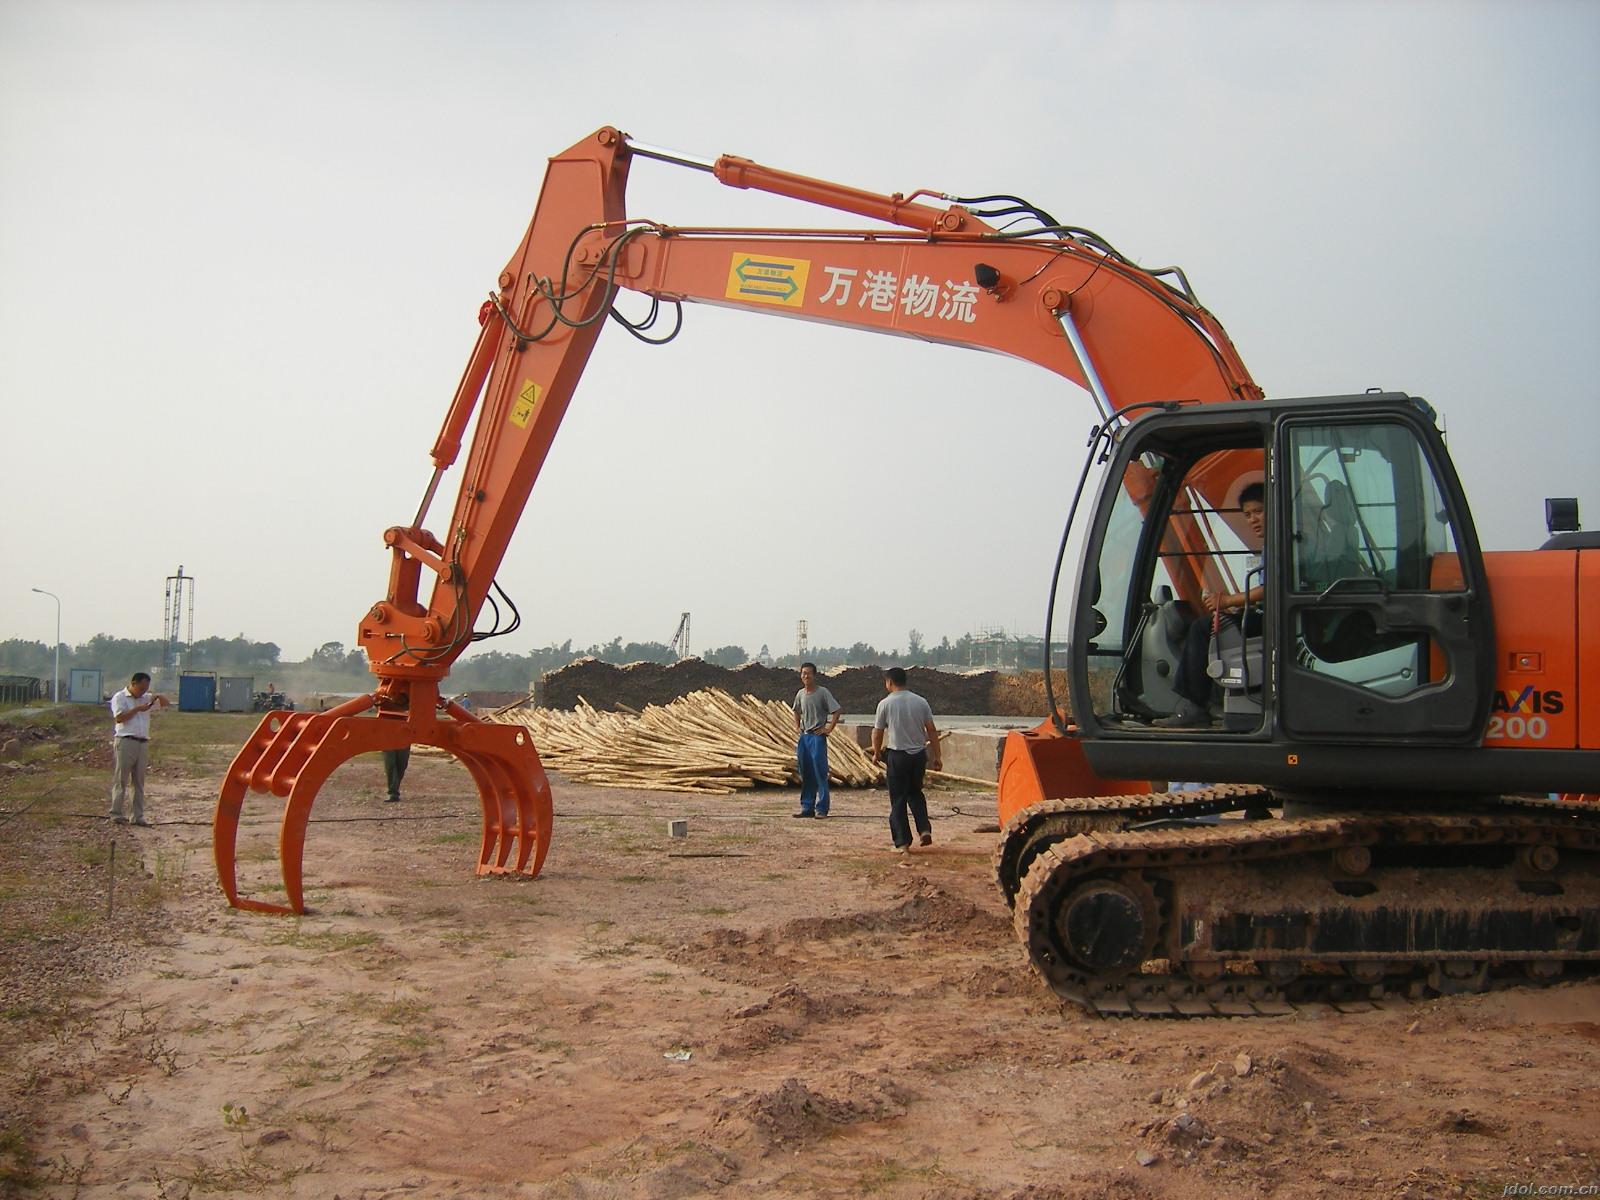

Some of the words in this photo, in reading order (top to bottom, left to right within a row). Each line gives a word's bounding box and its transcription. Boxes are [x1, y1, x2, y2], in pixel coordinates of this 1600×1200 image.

[819, 265, 980, 324] 万港物流
[1486, 716, 1547, 740] 200
